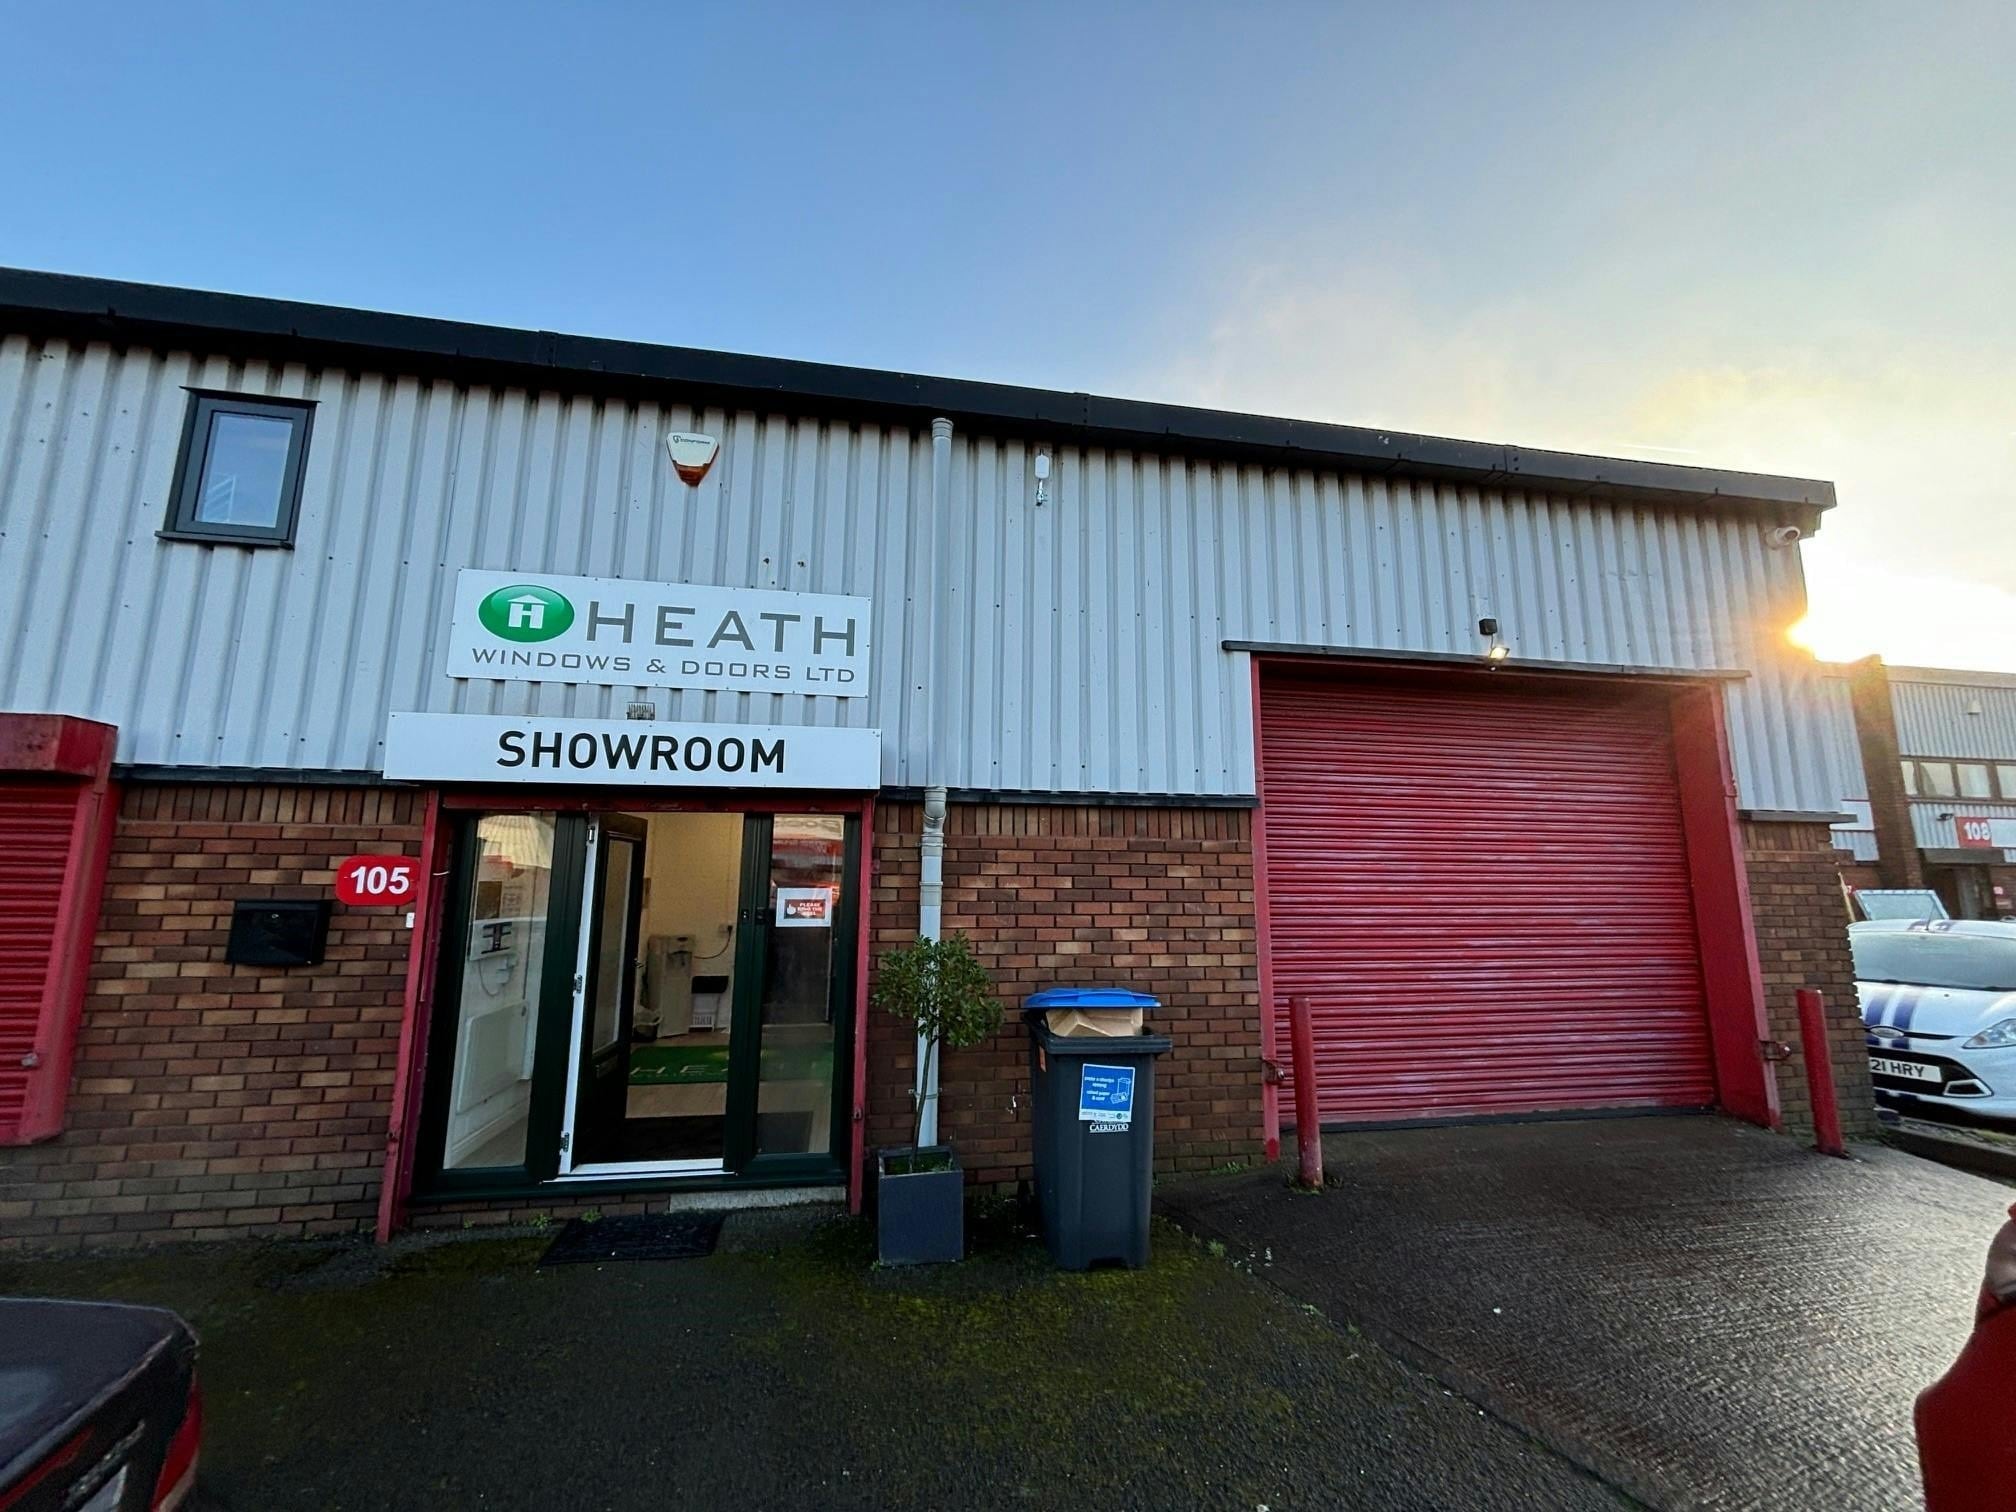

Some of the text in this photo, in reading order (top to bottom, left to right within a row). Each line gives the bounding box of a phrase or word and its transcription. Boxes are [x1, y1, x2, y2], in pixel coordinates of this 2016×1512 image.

[586, 600, 856, 657] HEATH
[472, 648, 855, 683] WINDOWS & DOORS LTD
[496, 730, 785, 774] SHOWROOM
[350, 865, 410, 895] 105
[1890, 1061, 1925, 1078] HRY
